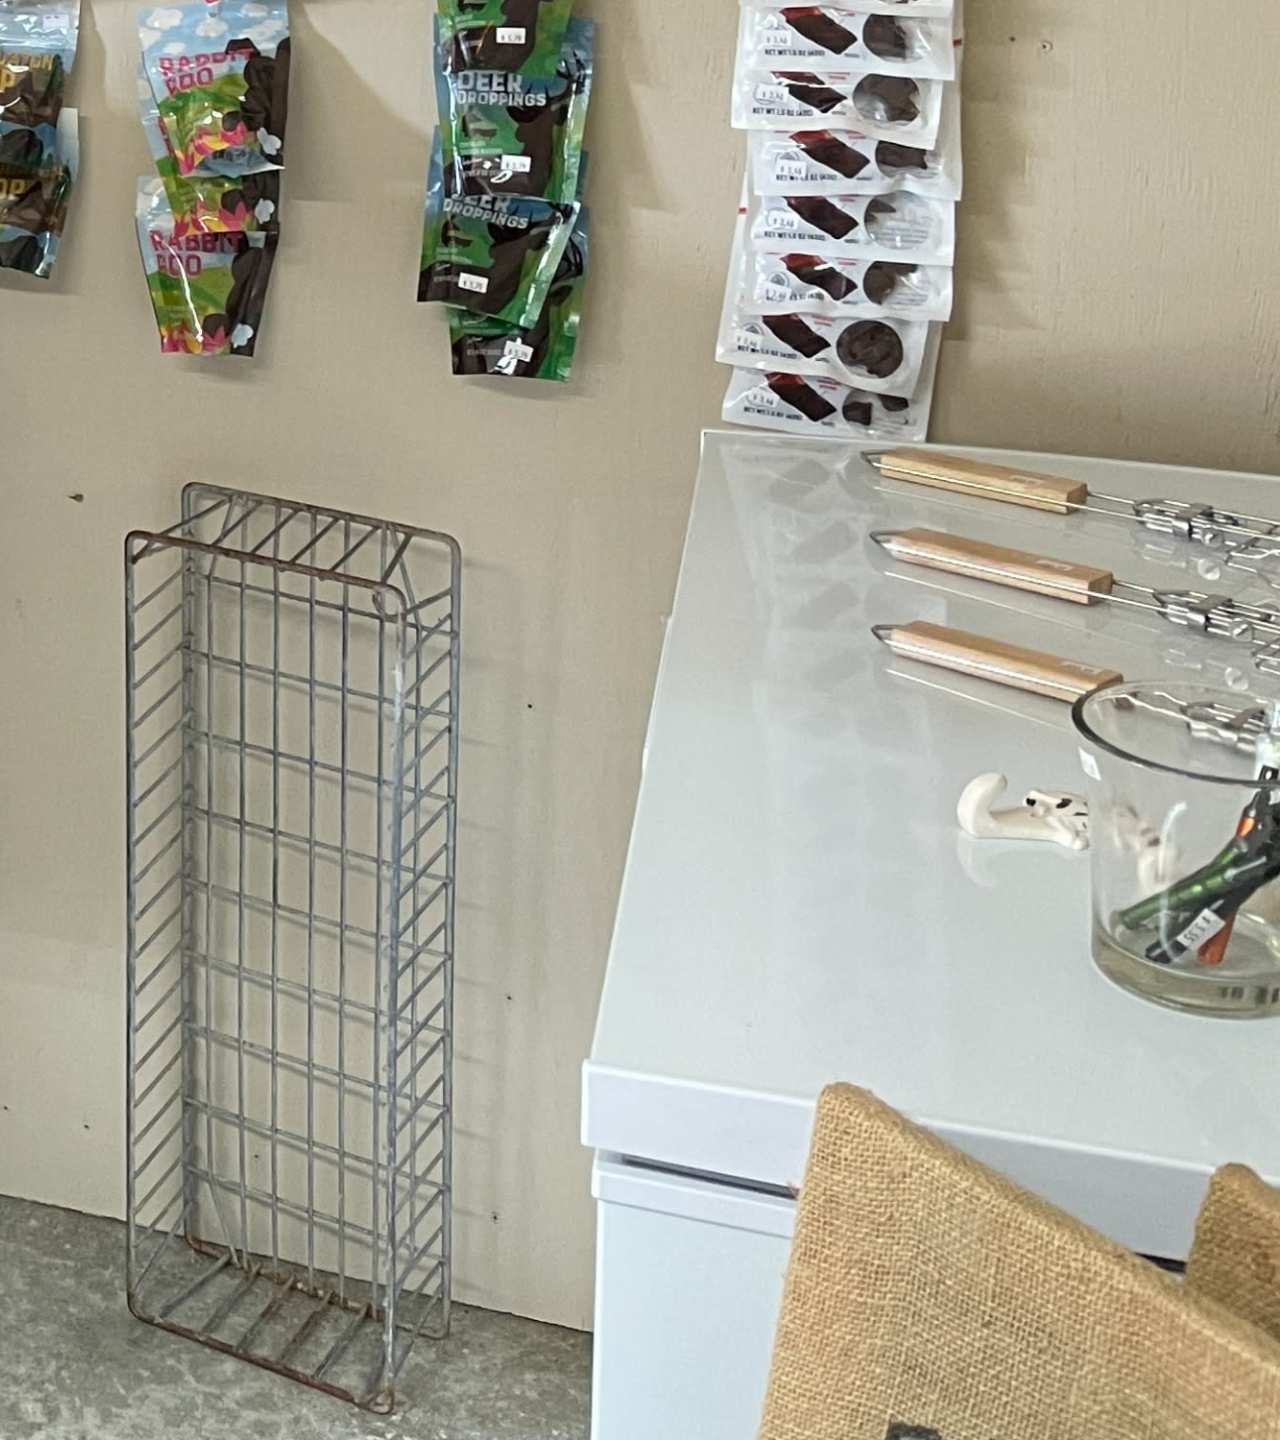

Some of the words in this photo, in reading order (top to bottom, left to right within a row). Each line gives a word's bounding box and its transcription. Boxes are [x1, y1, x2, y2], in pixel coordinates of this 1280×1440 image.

[458, 71, 522, 93] DEER
[457, 90, 547, 107] DROPPINGS
[442, 198, 529, 229] DROPPINGS
[149, 230, 246, 253] RABBIT
